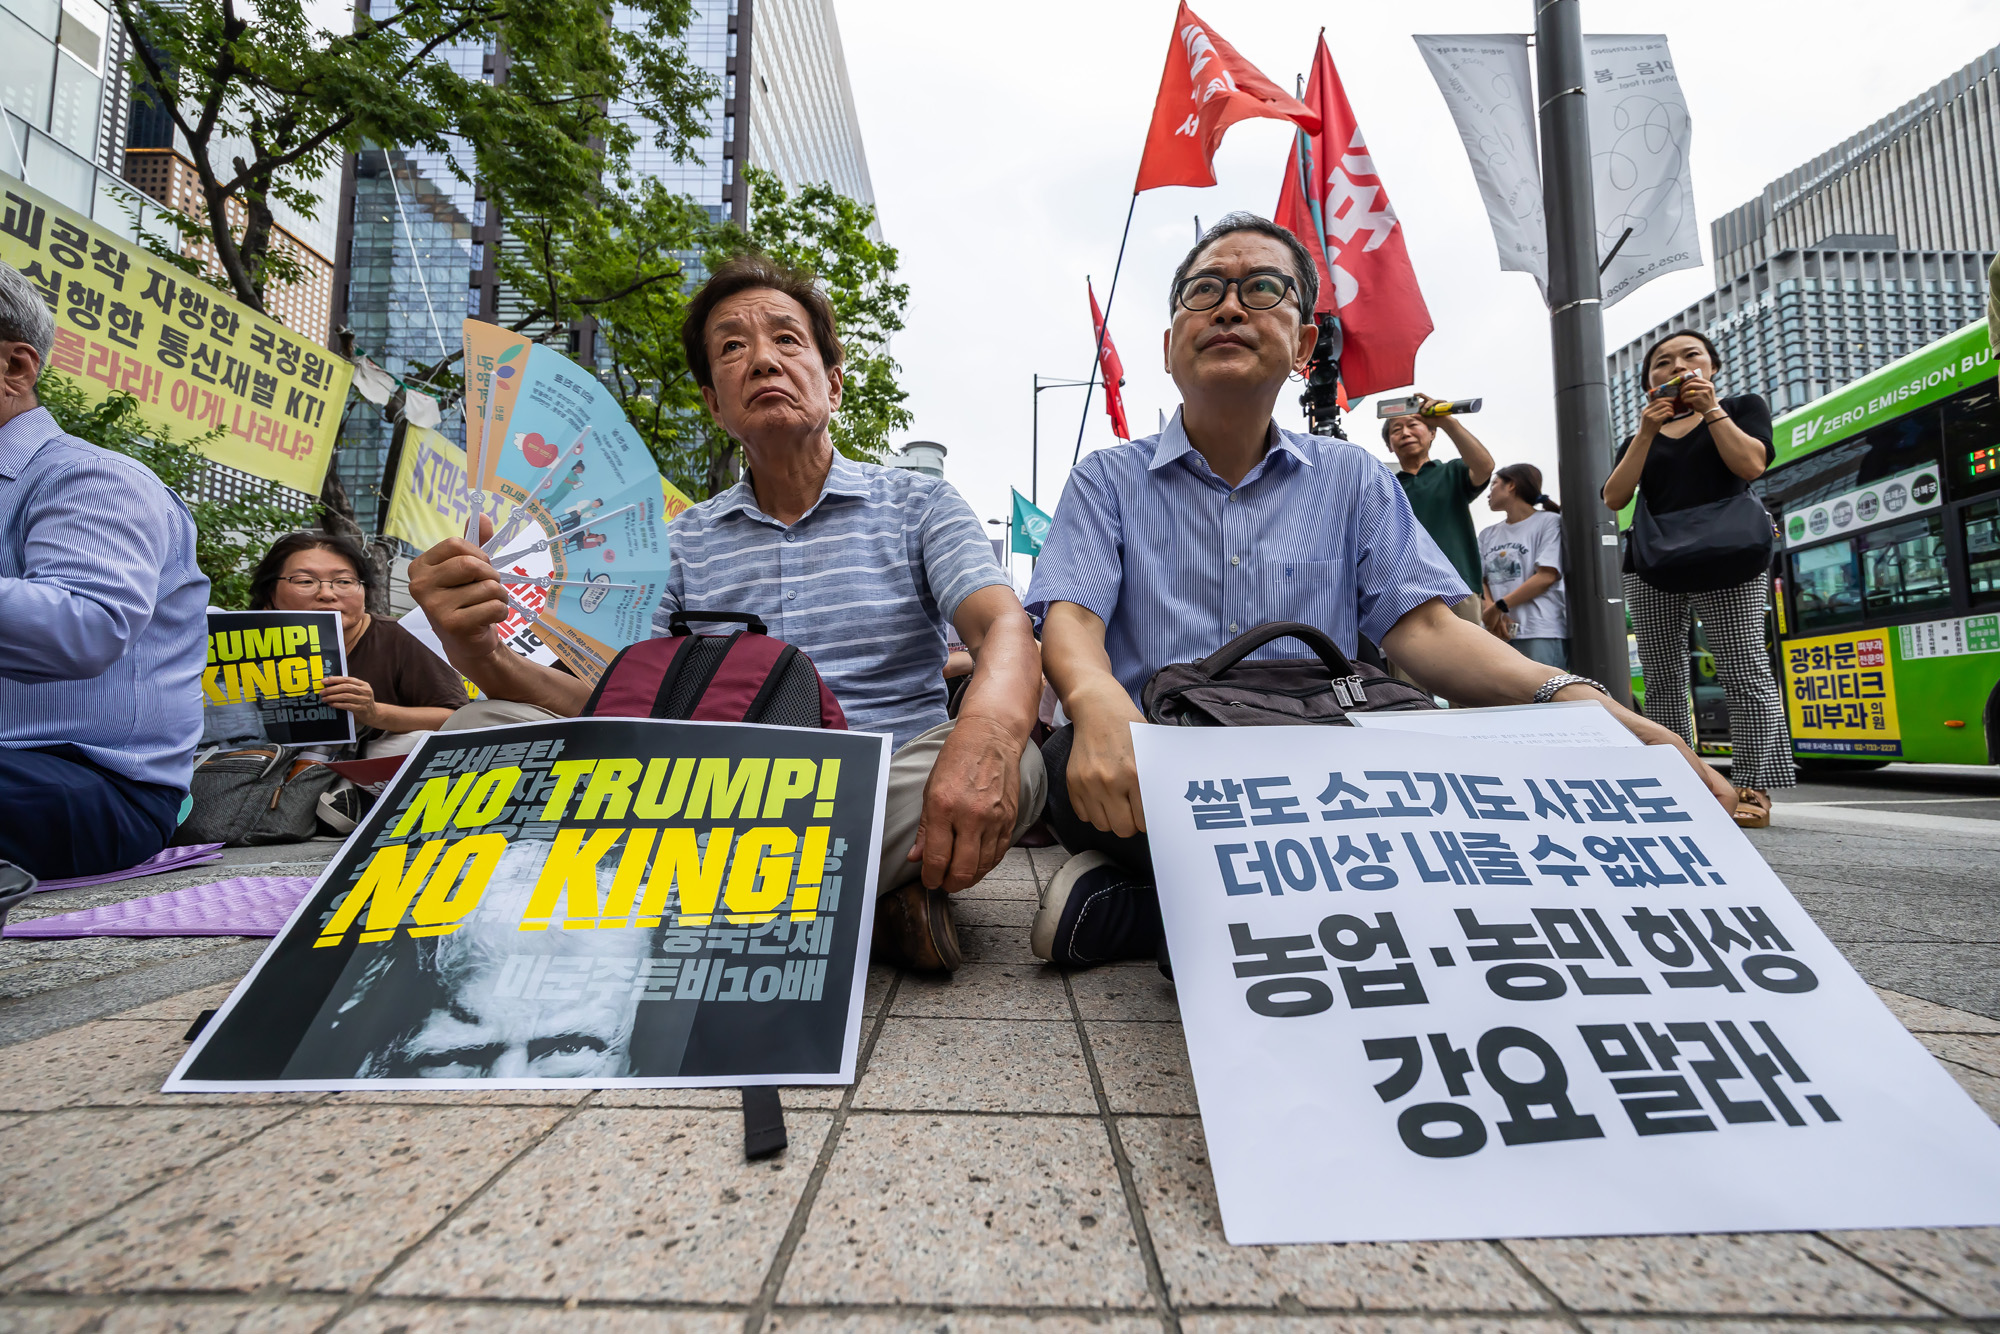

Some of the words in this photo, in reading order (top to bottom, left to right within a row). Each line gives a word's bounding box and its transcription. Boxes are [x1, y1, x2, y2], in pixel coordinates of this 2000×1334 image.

[1773, 190, 1800, 212] FOUR
[1800, 158, 1846, 194] SEASONS
[20, 260, 144, 350] 실행한
[158, 324, 278, 409] 통신재벌
[285, 386, 326, 428] KT!
[140, 266, 240, 347] 자행한
[250, 323, 334, 391] 국정원!
[1704, 295, 1774, 341] 대해상화재
[170, 379, 226, 430] 이게
[231, 404, 314, 461] 나라냐?
[1792, 416, 1824, 448] EV
[1823, 405, 1865, 436] ZERO
[1868, 367, 1957, 415] EMISSION
[1961, 347, 1991, 375] BU
[1884, 487, 1907, 501] 프레스
[1912, 482, 1937, 498] 경복궁
[207, 625, 321, 664] RUMP!
[1790, 642, 1856, 674] 광화문
[1857, 640, 1883, 652] 피부과
[1859, 653, 1885, 666] 전문의
[201, 655, 325, 708] KING!
[1794, 671, 1886, 701] 헤리티크
[1801, 702, 1868, 730] 피부과
[1870, 702, 1886, 730] 의원
[419, 739, 566, 779] 관세폭탄
[388, 766, 523, 838] NO
[540, 757, 842, 821] TRUMP!
[1184, 775, 1310, 831] 쌀도
[1317, 770, 1530, 821] 소고기도
[1523, 777, 1692, 824] 사과도
[312, 833, 508, 948] NO
[518, 826, 833, 932] KING!
[1215, 834, 1400, 896] 더이상
[1401, 830, 1533, 887] 내줄
[1530, 833, 1591, 887] 수
[1596, 834, 1727, 889] 없다!
[1624, 906, 1820, 995] 희생
[493, 958, 829, 1003] 미군주둔비10배
[1363, 1026, 1605, 1159] 강요
[1576, 1021, 1843, 1137] 말라!
